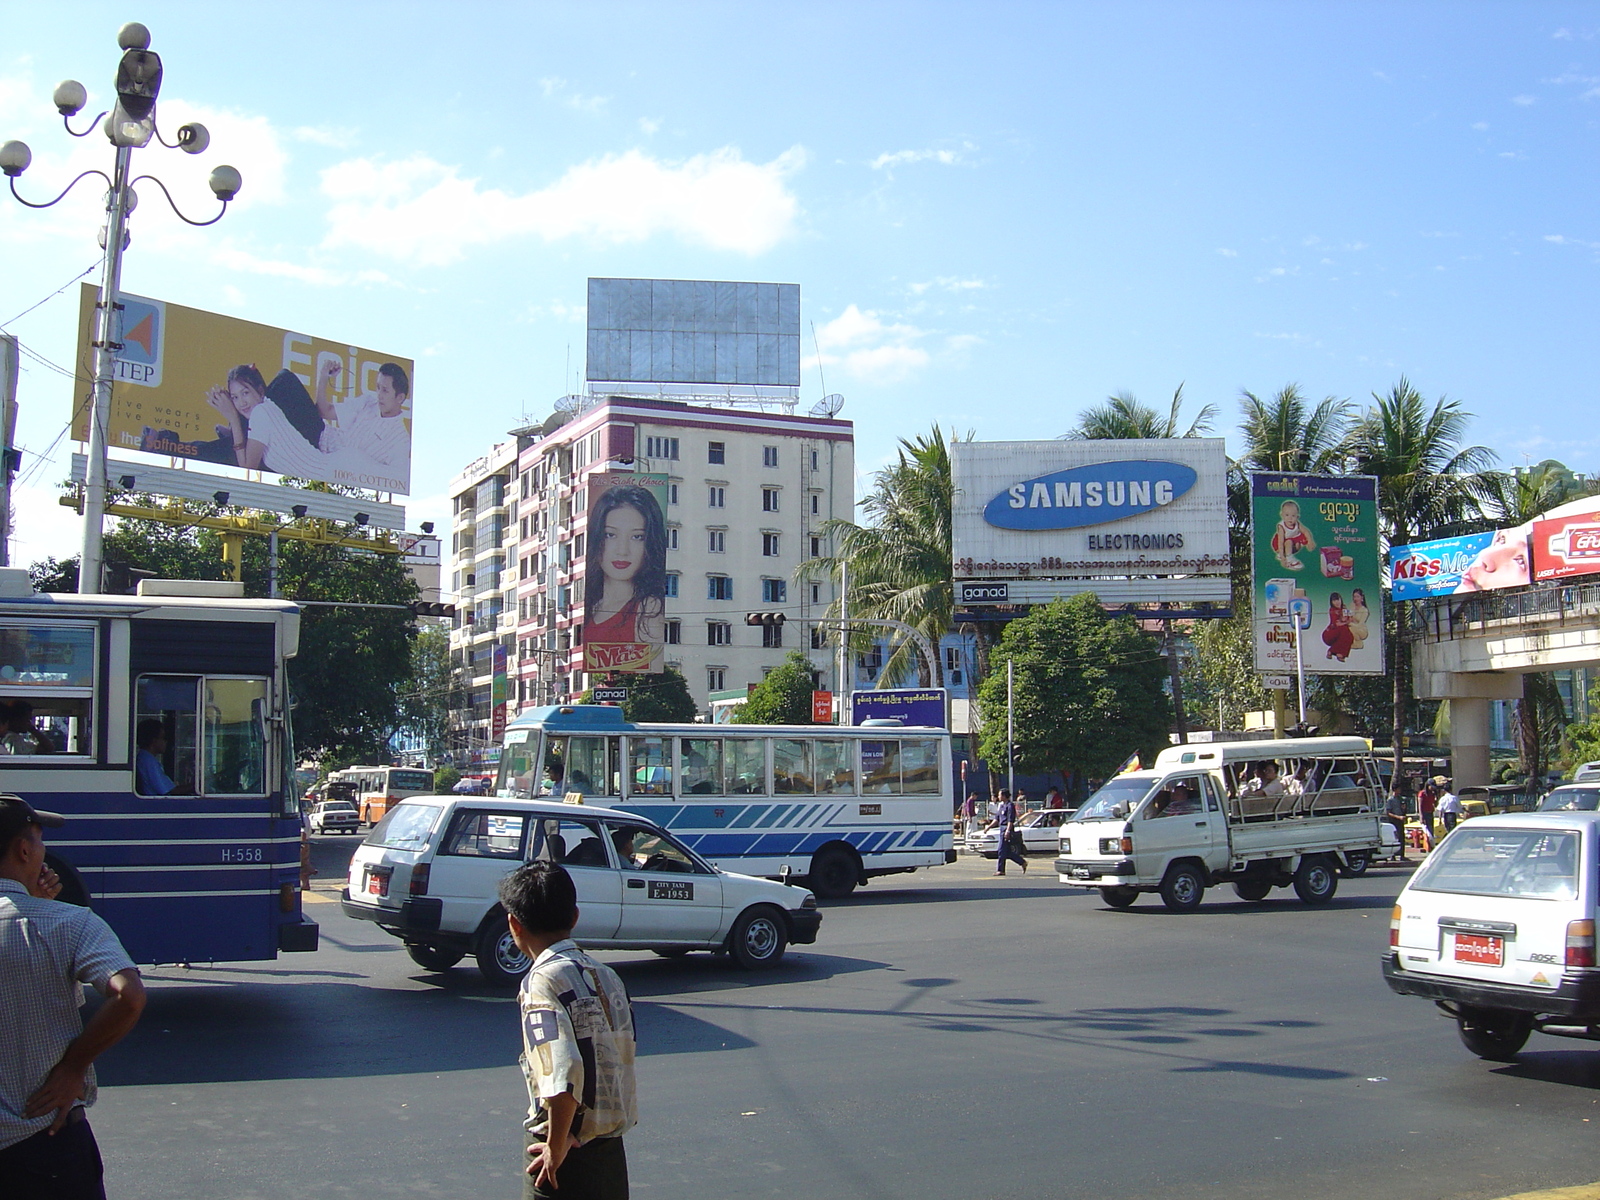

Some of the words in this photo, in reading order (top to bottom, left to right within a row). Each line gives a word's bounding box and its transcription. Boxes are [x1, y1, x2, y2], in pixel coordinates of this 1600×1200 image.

[155, 405, 200, 420] wears
[155, 417, 200, 431] wears
[121, 431, 142, 447] the
[334, 469, 357, 482] 100%
[359, 473, 407, 490] COTTON
[610, 476, 635, 489] Right
[638, 475, 666, 488] Choice
[1008, 480, 1174, 510] SAMSUNG
[1088, 533, 1184, 551] ELECTRONICS
[964, 585, 1007, 600] ganad
[595, 689, 626, 700] ganad
[221, 848, 263, 862] H-558
[1530, 953, 1558, 963] ROSE
